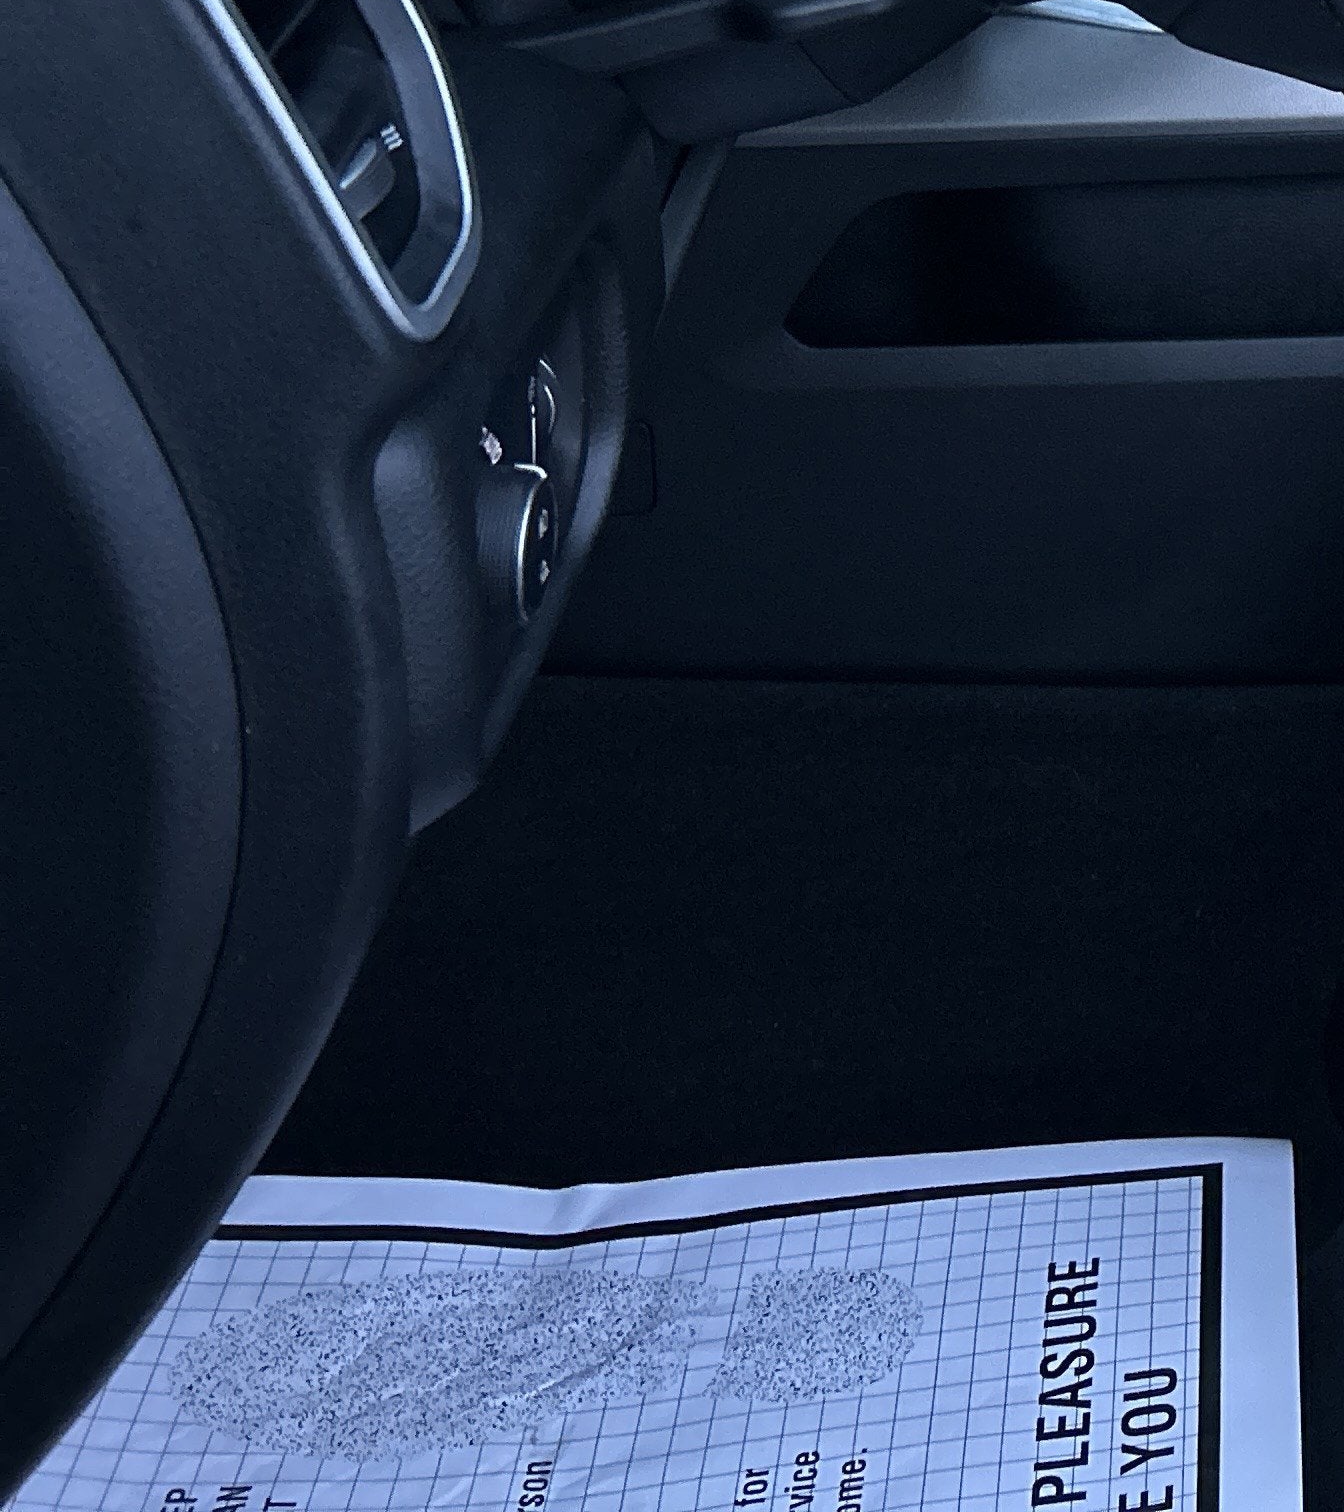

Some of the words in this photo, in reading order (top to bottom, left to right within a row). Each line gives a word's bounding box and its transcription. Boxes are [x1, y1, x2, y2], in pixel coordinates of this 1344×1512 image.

[1031, 1256, 1101, 1506] PLEASURE
[1119, 1366, 1178, 1476] YOU
[733, 1468, 770, 1507] for
[783, 1450, 820, 1512] vice
